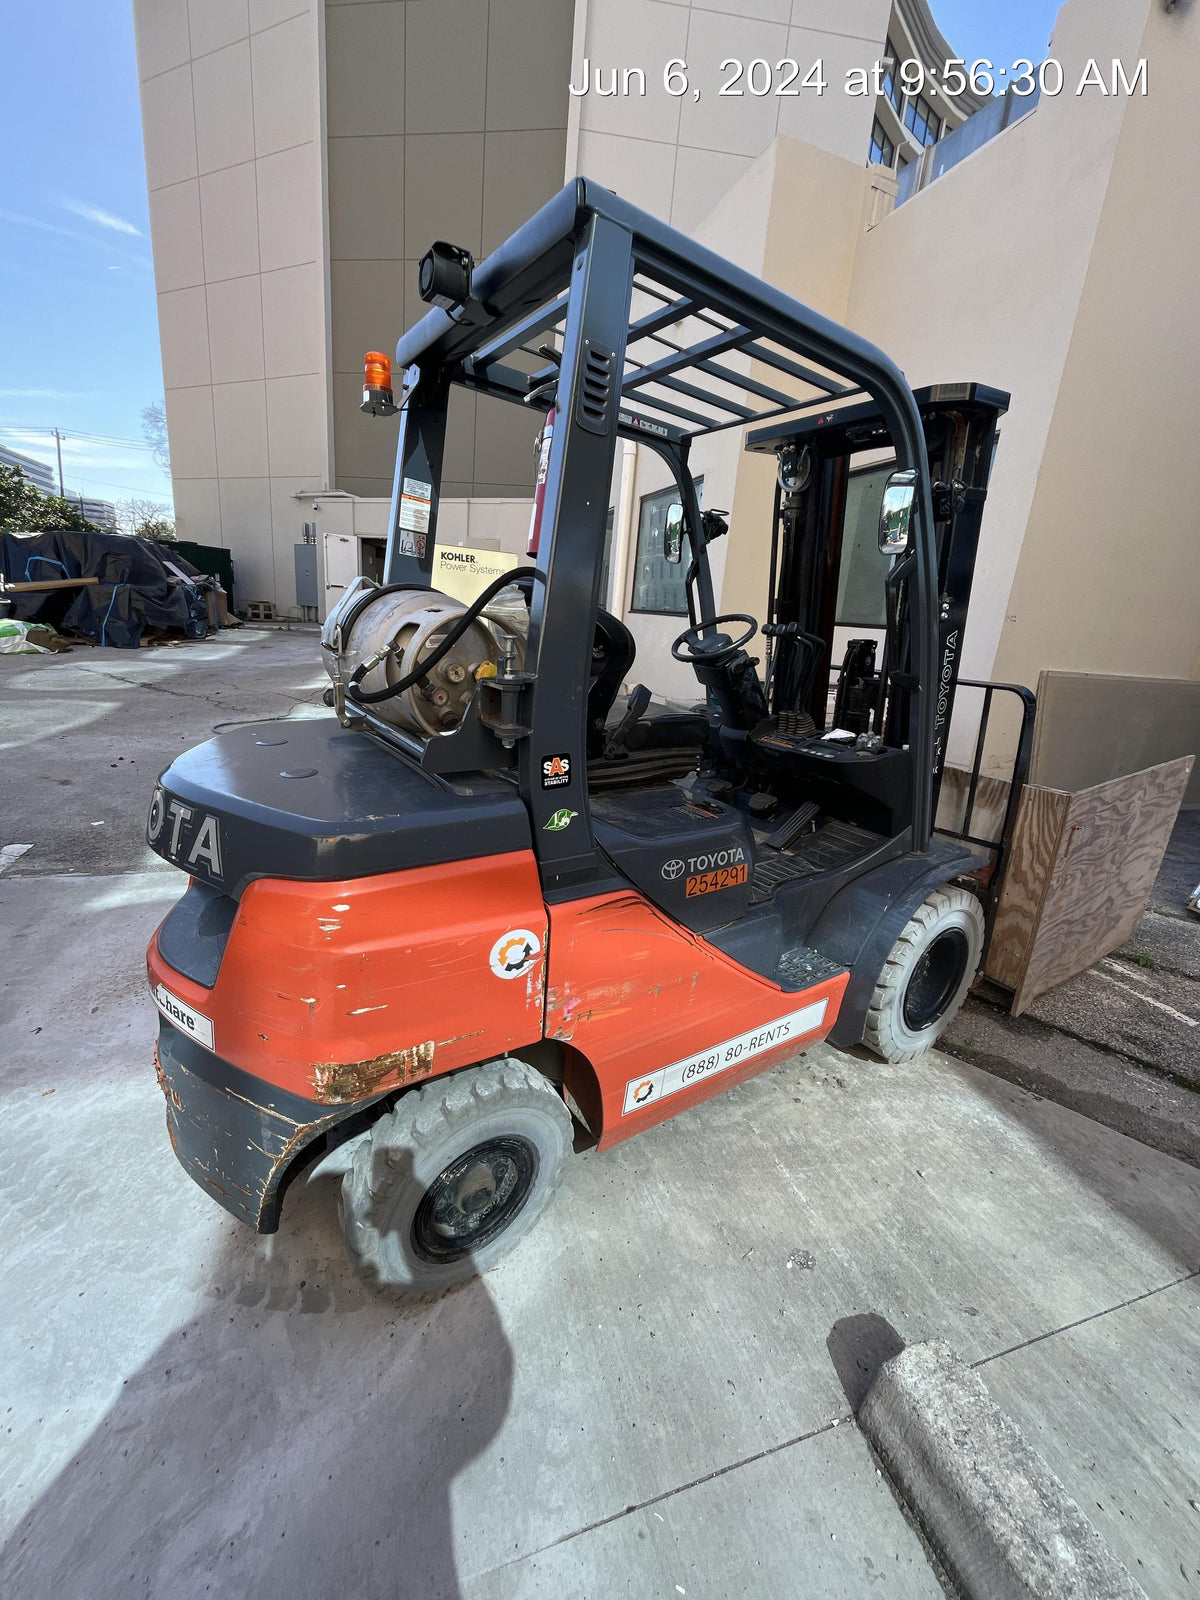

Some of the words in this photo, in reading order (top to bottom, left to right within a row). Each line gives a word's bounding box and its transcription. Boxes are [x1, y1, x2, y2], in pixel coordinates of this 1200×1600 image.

[440, 552, 476, 563] KOHLER
[440, 561, 467, 572] Power
[469, 564, 506, 575] Systems
[935, 630, 958, 730] TOYOTA
[543, 757, 569, 776] SAS
[687, 847, 744, 873] TOYOTA
[687, 864, 746, 897] 254291
[681, 1053, 720, 1082] (888)
[724, 1021, 791, 1062] 80-RENTS
